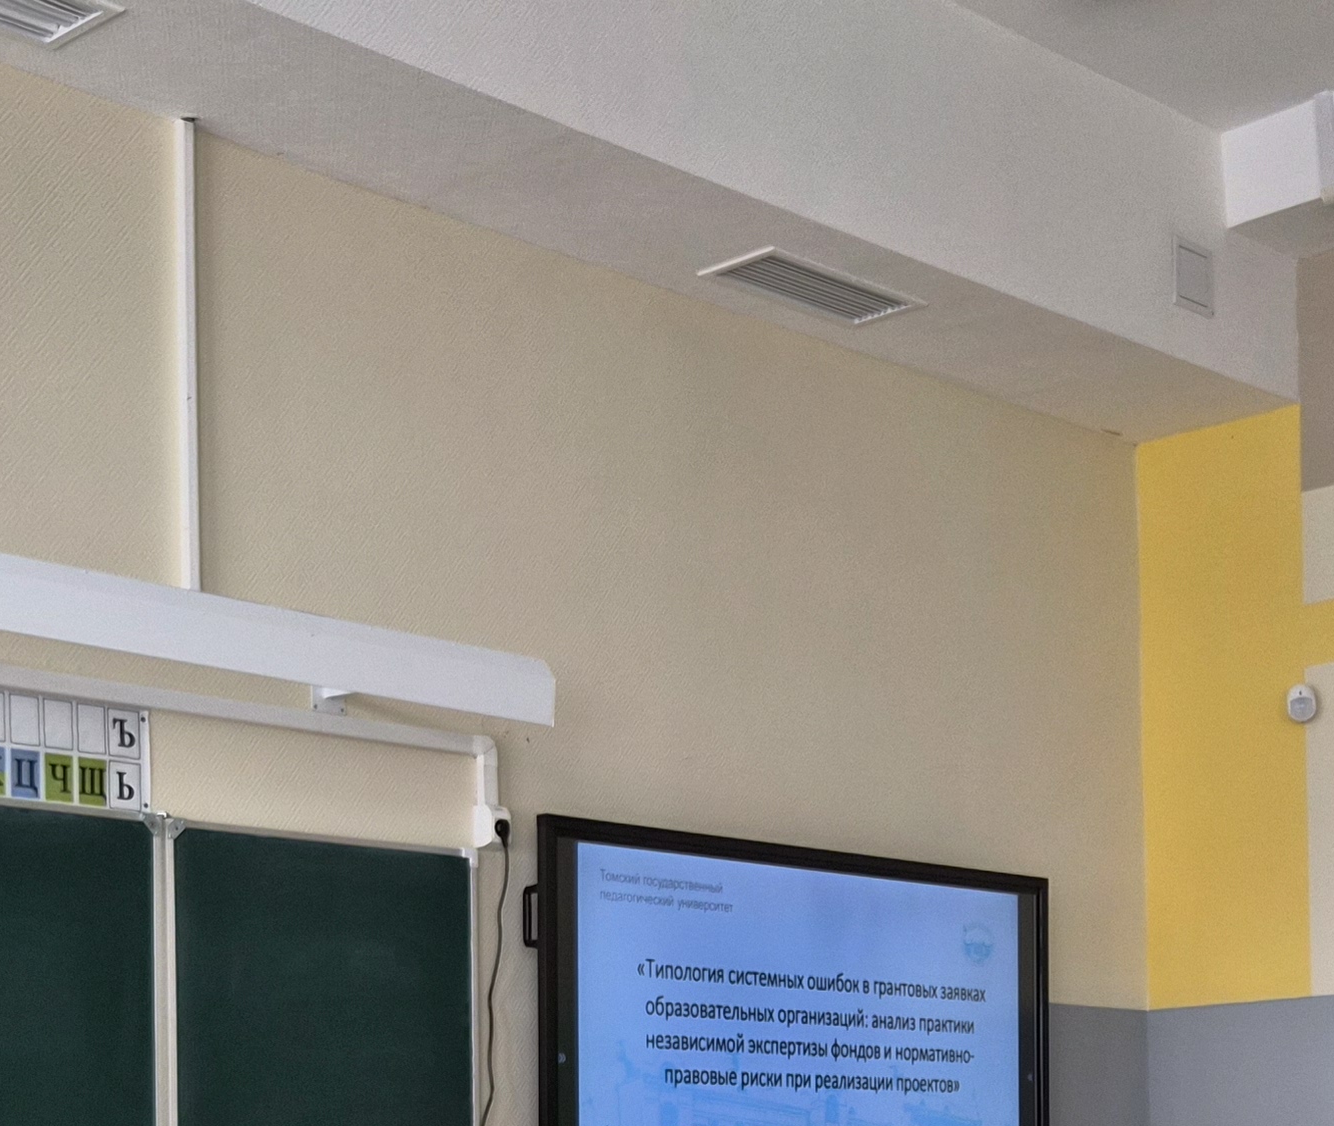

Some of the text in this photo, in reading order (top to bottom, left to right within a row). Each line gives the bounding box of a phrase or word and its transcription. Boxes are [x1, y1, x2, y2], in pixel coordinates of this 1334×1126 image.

[112, 717, 136, 749] Ъ
[14, 758, 39, 798] Ц
[49, 762, 71, 794] Ч
[78, 766, 107, 805] Щ
[116, 771, 135, 801] Ь
[600, 868, 641, 885] Томский
[637, 958, 986, 1003] «Типология системных ошибок в грантовых заявках
[645, 995, 975, 1036] образовательных организаций: анализ практики
[646, 1033, 975, 1065] независимой экспертизы фондов и нормативно-
[664, 1068, 960, 1095] правовые риски при реализации проектов»
